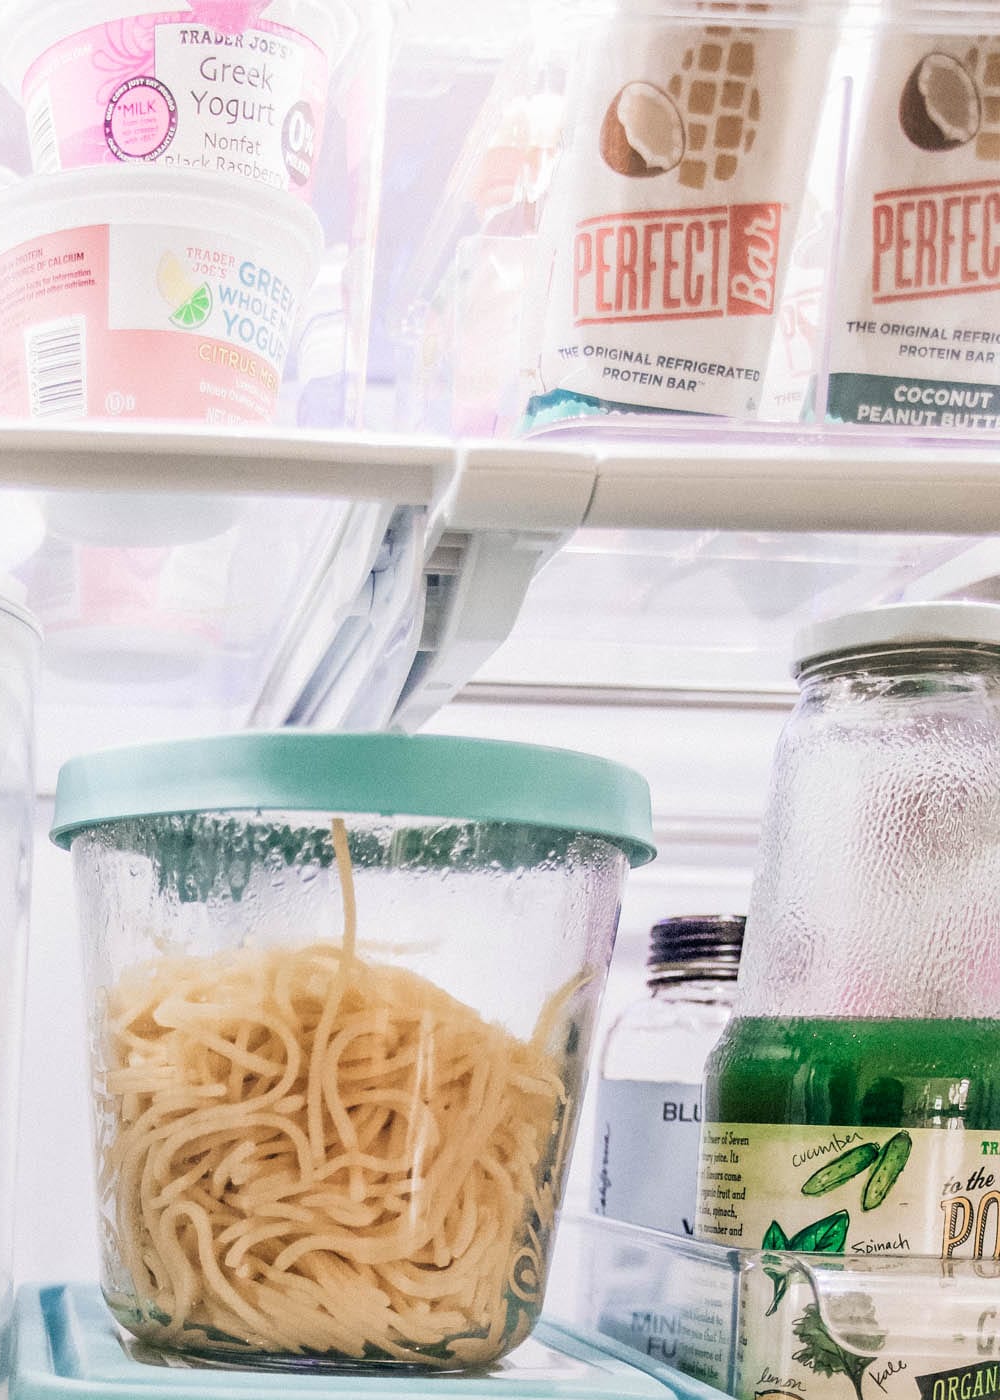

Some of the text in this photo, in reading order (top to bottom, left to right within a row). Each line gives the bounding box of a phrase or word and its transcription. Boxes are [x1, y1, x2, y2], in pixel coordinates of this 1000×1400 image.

[180, 30, 244, 49] TRADER
[199, 56, 273, 93] Greek
[191, 90, 276, 126] Yogurt
[204, 132, 262, 156] Nonfat
[186, 247, 236, 268] TRADER
[573, 207, 777, 317] PERFECT Bar
[219, 284, 278, 327] WHOLE
[846, 321, 877, 334] THE
[880, 323, 948, 341] ORIGINAL
[199, 343, 258, 377] CITRUS
[583, 345, 652, 367] ORIGINAL
[656, 355, 760, 382] REFRIGERATED
[899, 345, 961, 361] PROTEIN
[602, 367, 663, 388] PROTEIN
[894, 385, 994, 409] COCONUT
[857, 404, 938, 425] PEANUT
[728, 1131, 749, 1146] Seven
[791, 1131, 864, 1169] cucumber
[717, 1185, 731, 1200] fruit
[732, 1187, 746, 1200] and
[942, 1166, 995, 1196] to the
[729, 1223, 743, 1237] and
[756, 1368, 807, 1392] lemon
[869, 1360, 907, 1394] kale
